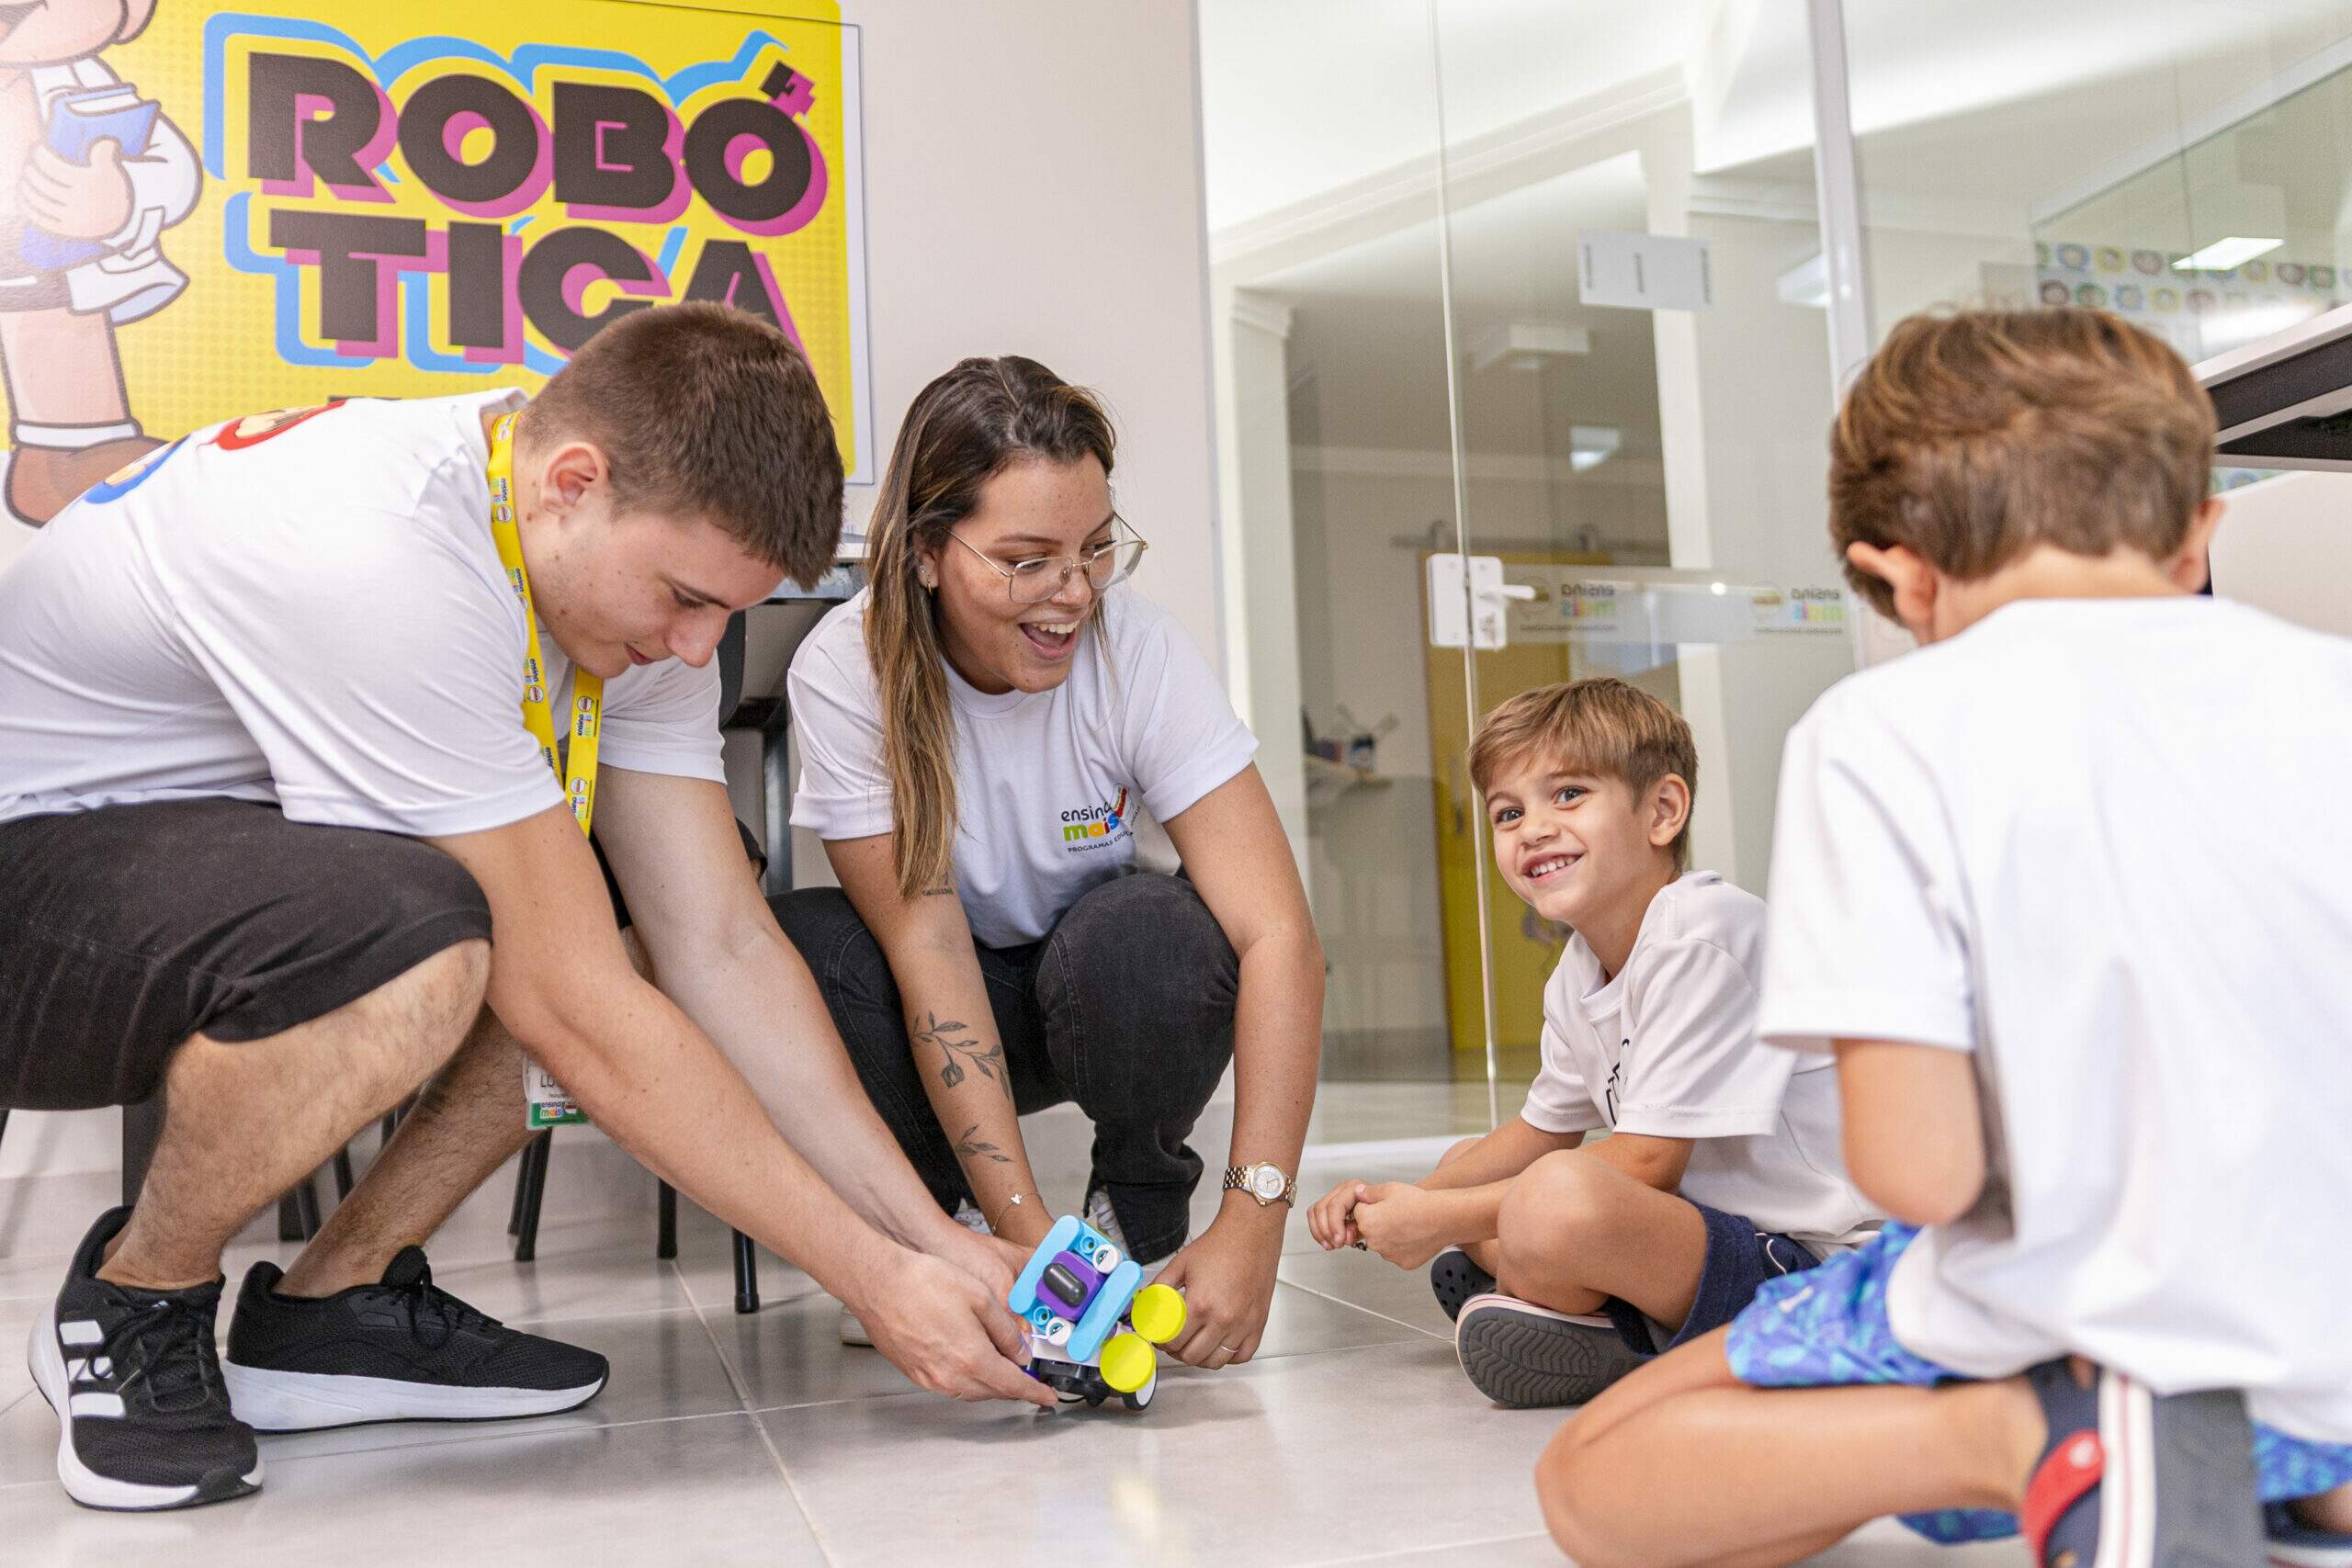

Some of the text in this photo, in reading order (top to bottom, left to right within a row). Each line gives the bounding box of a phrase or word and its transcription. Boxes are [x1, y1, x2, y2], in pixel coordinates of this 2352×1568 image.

[248, 51, 822, 228] ROBÓ
[1063, 811, 1119, 841] mais
[1068, 840, 1113, 852] PROGRAMAS
